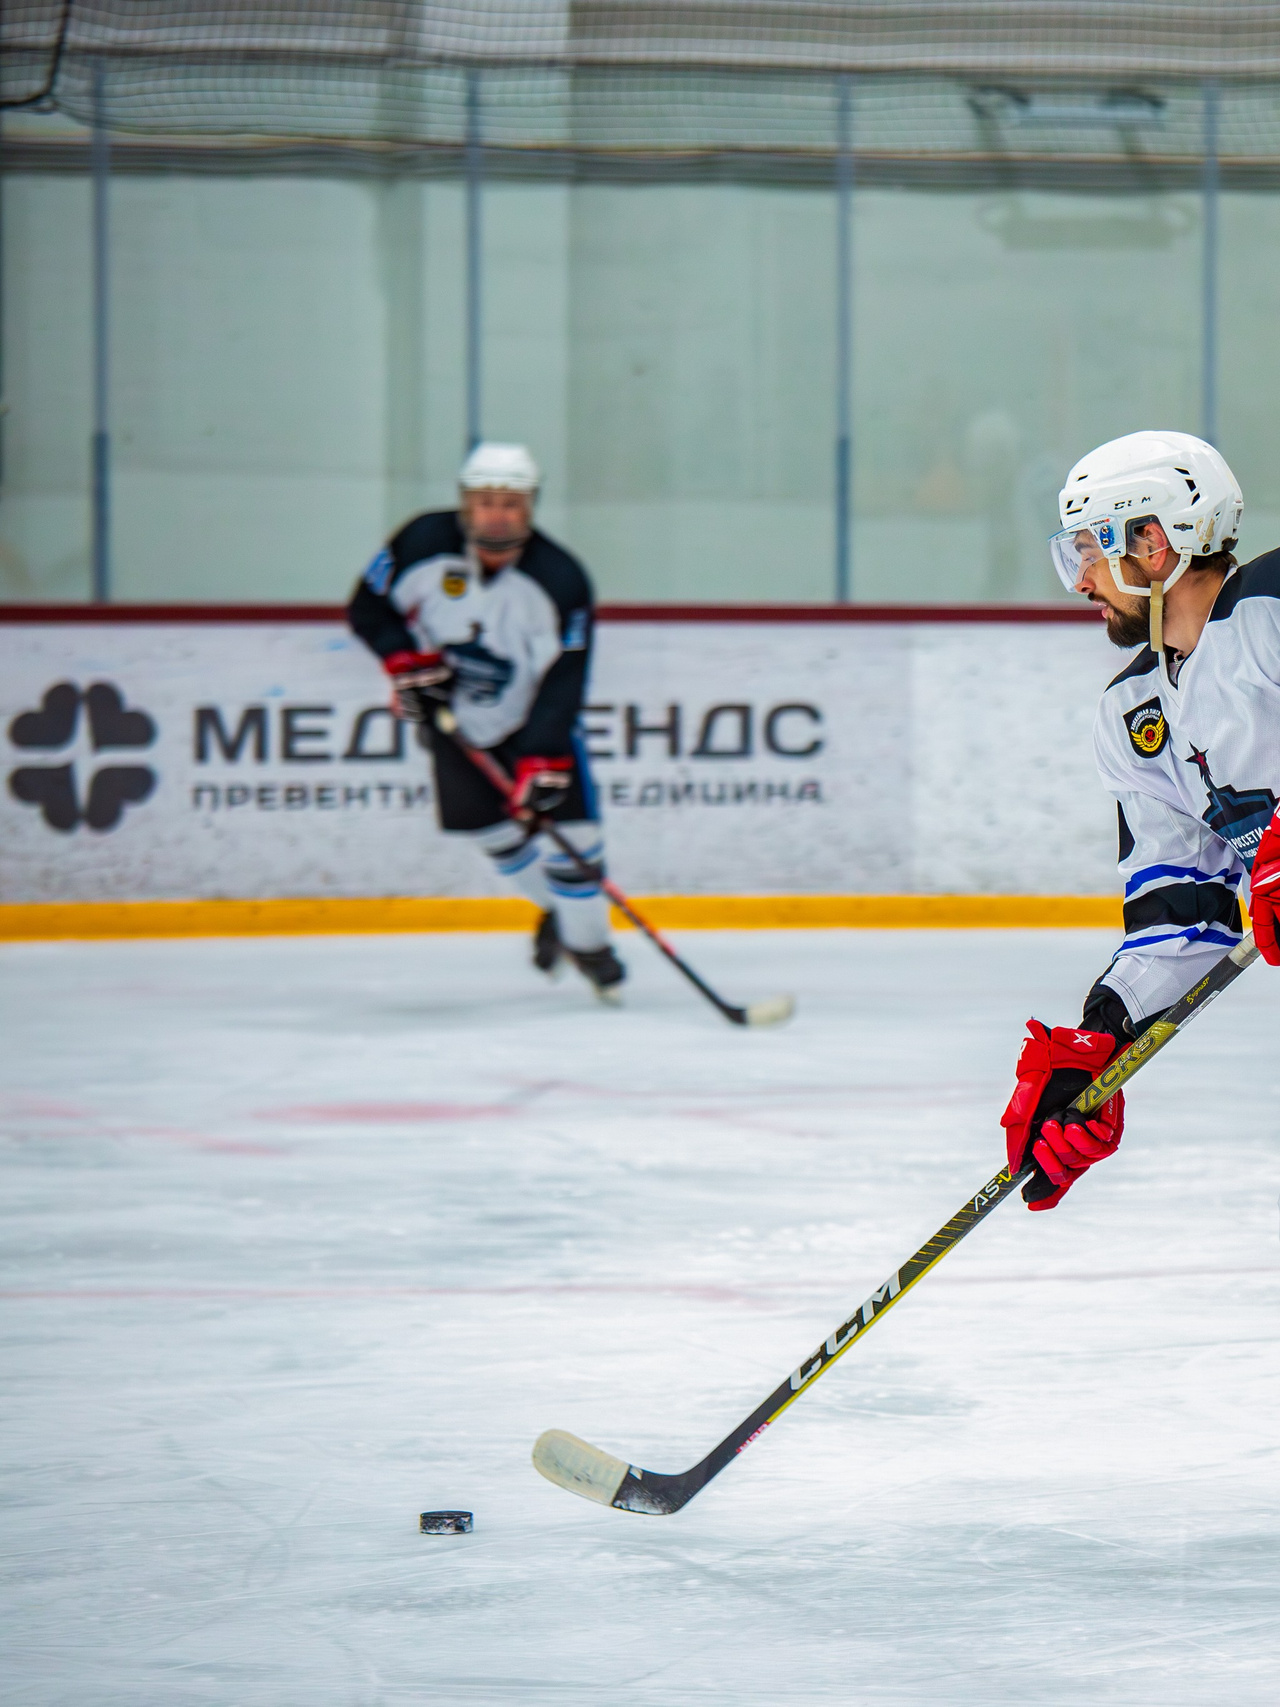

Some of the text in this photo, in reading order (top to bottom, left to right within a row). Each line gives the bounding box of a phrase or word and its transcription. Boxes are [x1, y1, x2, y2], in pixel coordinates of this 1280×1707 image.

[195, 704, 825, 762] МЕДЕНДС
[609, 780, 824, 809] ЕДИЦИНА
[790, 1268, 901, 1391] CCM
